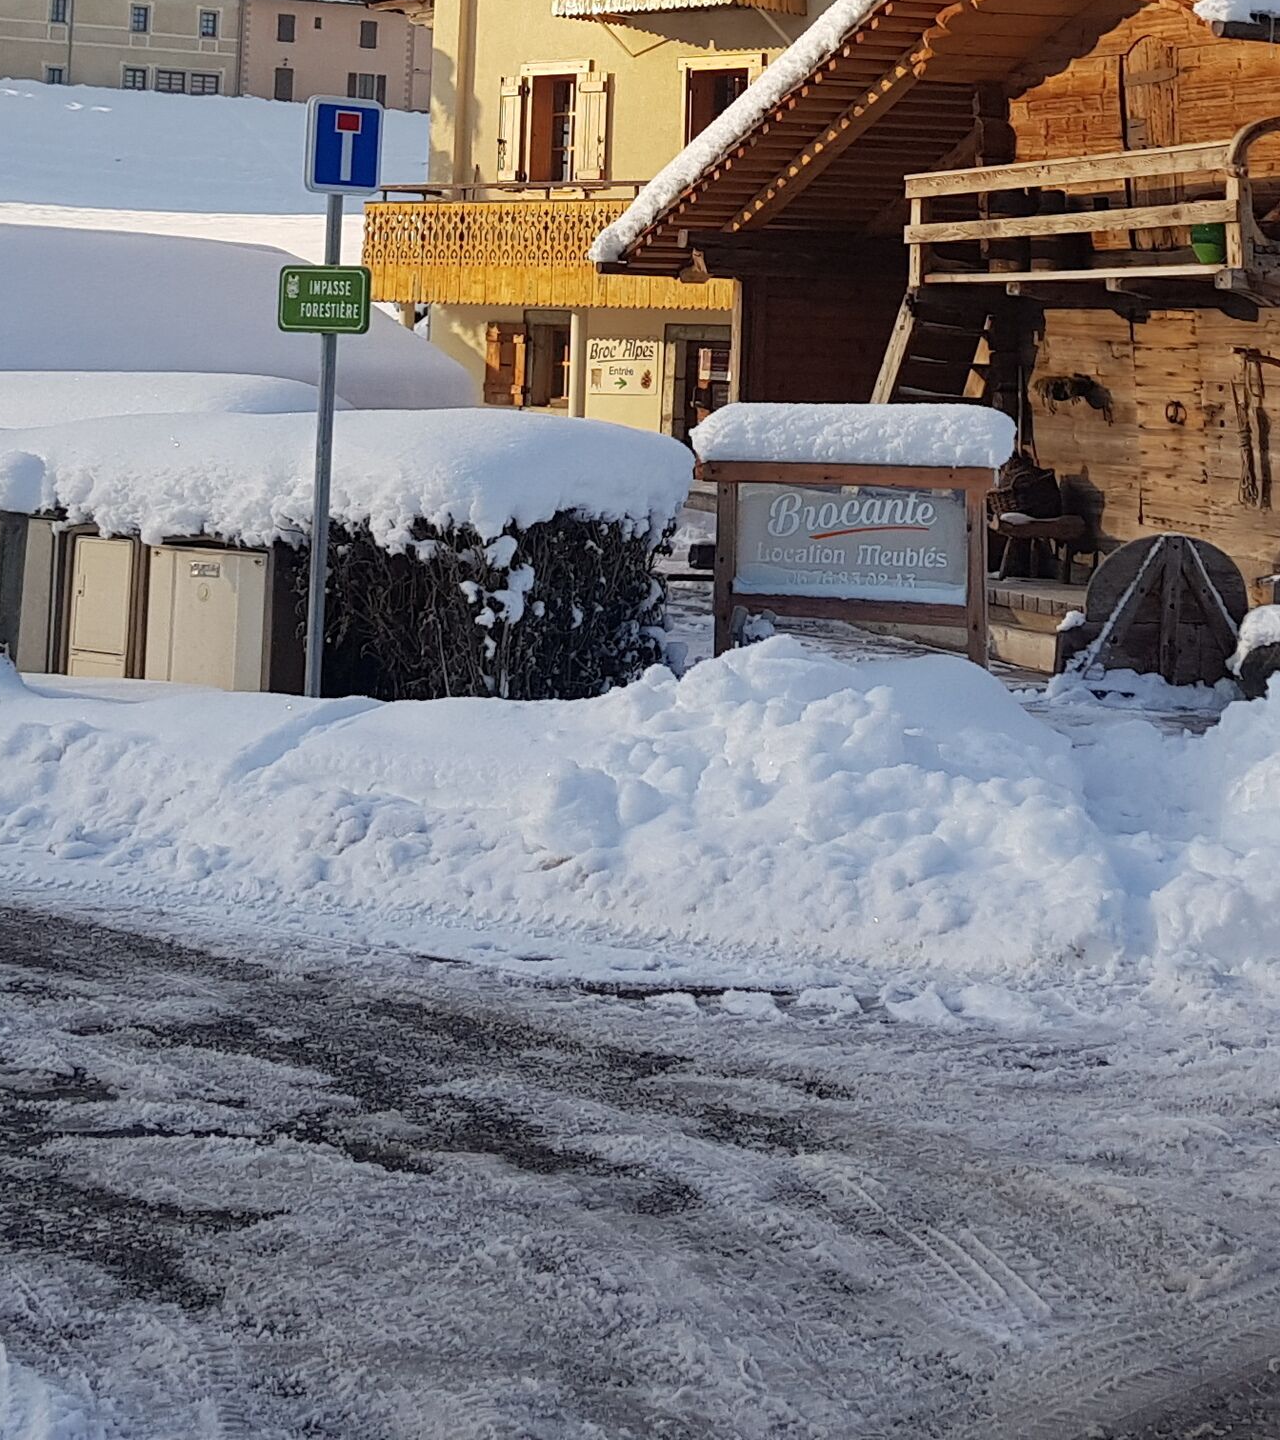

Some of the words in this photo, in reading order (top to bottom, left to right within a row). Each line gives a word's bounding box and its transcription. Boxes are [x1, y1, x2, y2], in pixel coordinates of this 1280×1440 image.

[309, 279, 352, 296] IMPASSE
[300, 300, 360, 319] FORESTIÈRE
[622, 340, 654, 360] Alpes
[608, 366, 634, 376] Entrée
[767, 492, 938, 537] Brocante
[757, 541, 846, 565] Location
[856, 545, 948, 568] Meublés
